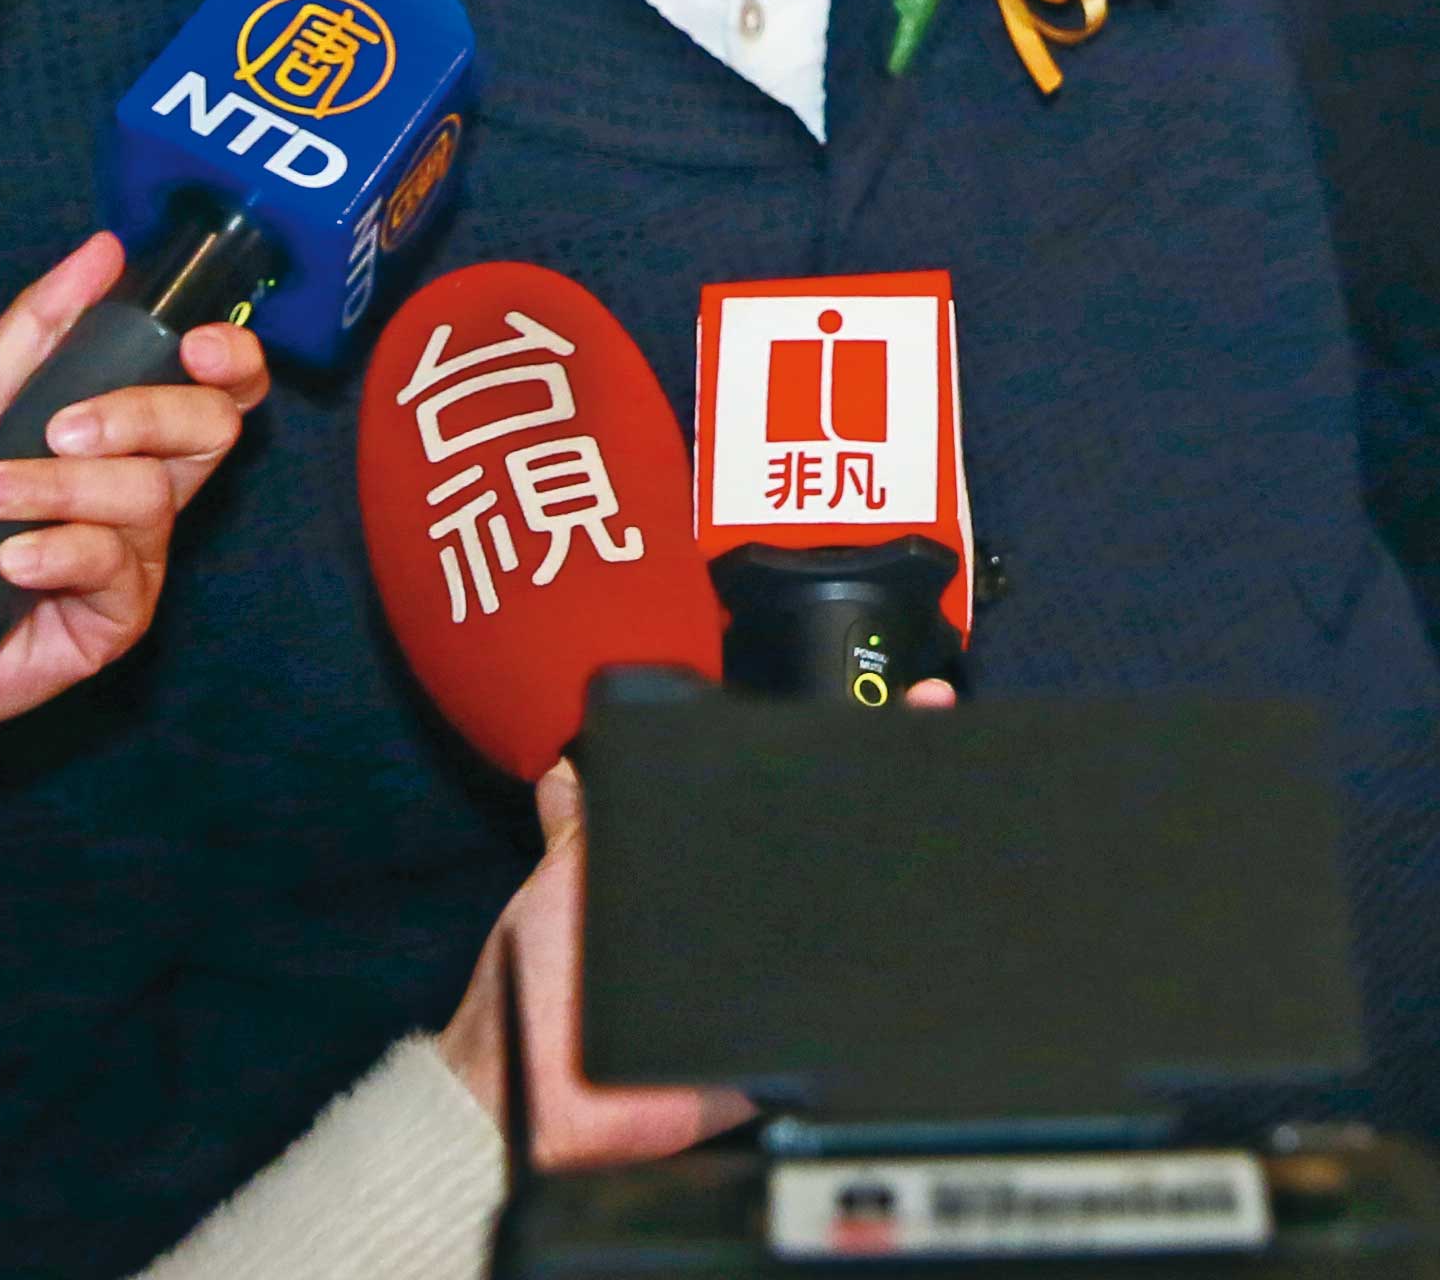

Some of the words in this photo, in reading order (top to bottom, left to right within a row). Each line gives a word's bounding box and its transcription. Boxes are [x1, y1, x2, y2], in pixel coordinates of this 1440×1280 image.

[151, 70, 348, 189] NTD
[396, 310, 646, 625] 台視
[764, 451, 887, 511] 非凡
